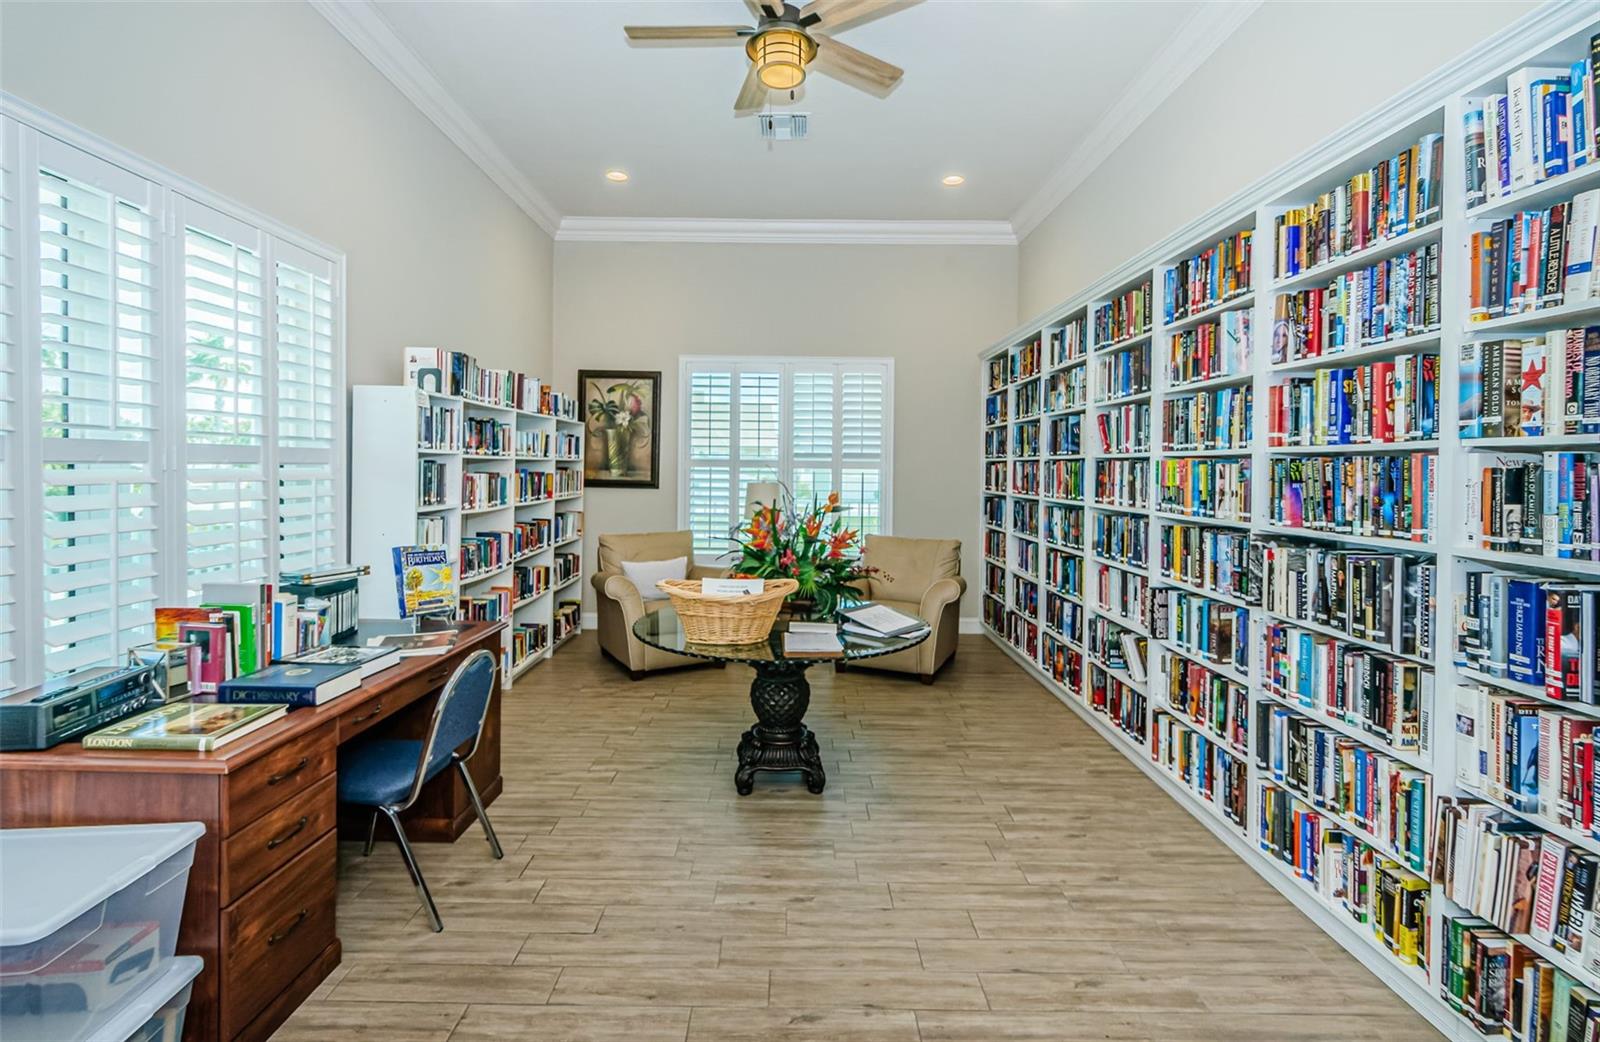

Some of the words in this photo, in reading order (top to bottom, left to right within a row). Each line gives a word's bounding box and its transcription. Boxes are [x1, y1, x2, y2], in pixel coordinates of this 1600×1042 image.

[1549, 235, 1560, 259] LITTLE
[1547, 259, 1559, 293] REVENGE
[1492, 345, 1500, 388] AMERICAN
[1585, 356, 1598, 367] NO
[1585, 367, 1600, 401] ORDINARY
[1491, 390, 1500, 426] SOLDIR
[408, 554, 446, 566] BIRTHDAYS
[1515, 609, 1523, 641] RICHARD
[1363, 654, 1371, 690] MURDOCH
[232, 689, 300, 702] DICTIONARY
[87, 737, 134, 747] LONDON
[1540, 733, 1550, 780] WOODWARD
[1540, 852, 1557, 890] PUBLIC
[1568, 908, 1584, 933] FBI
